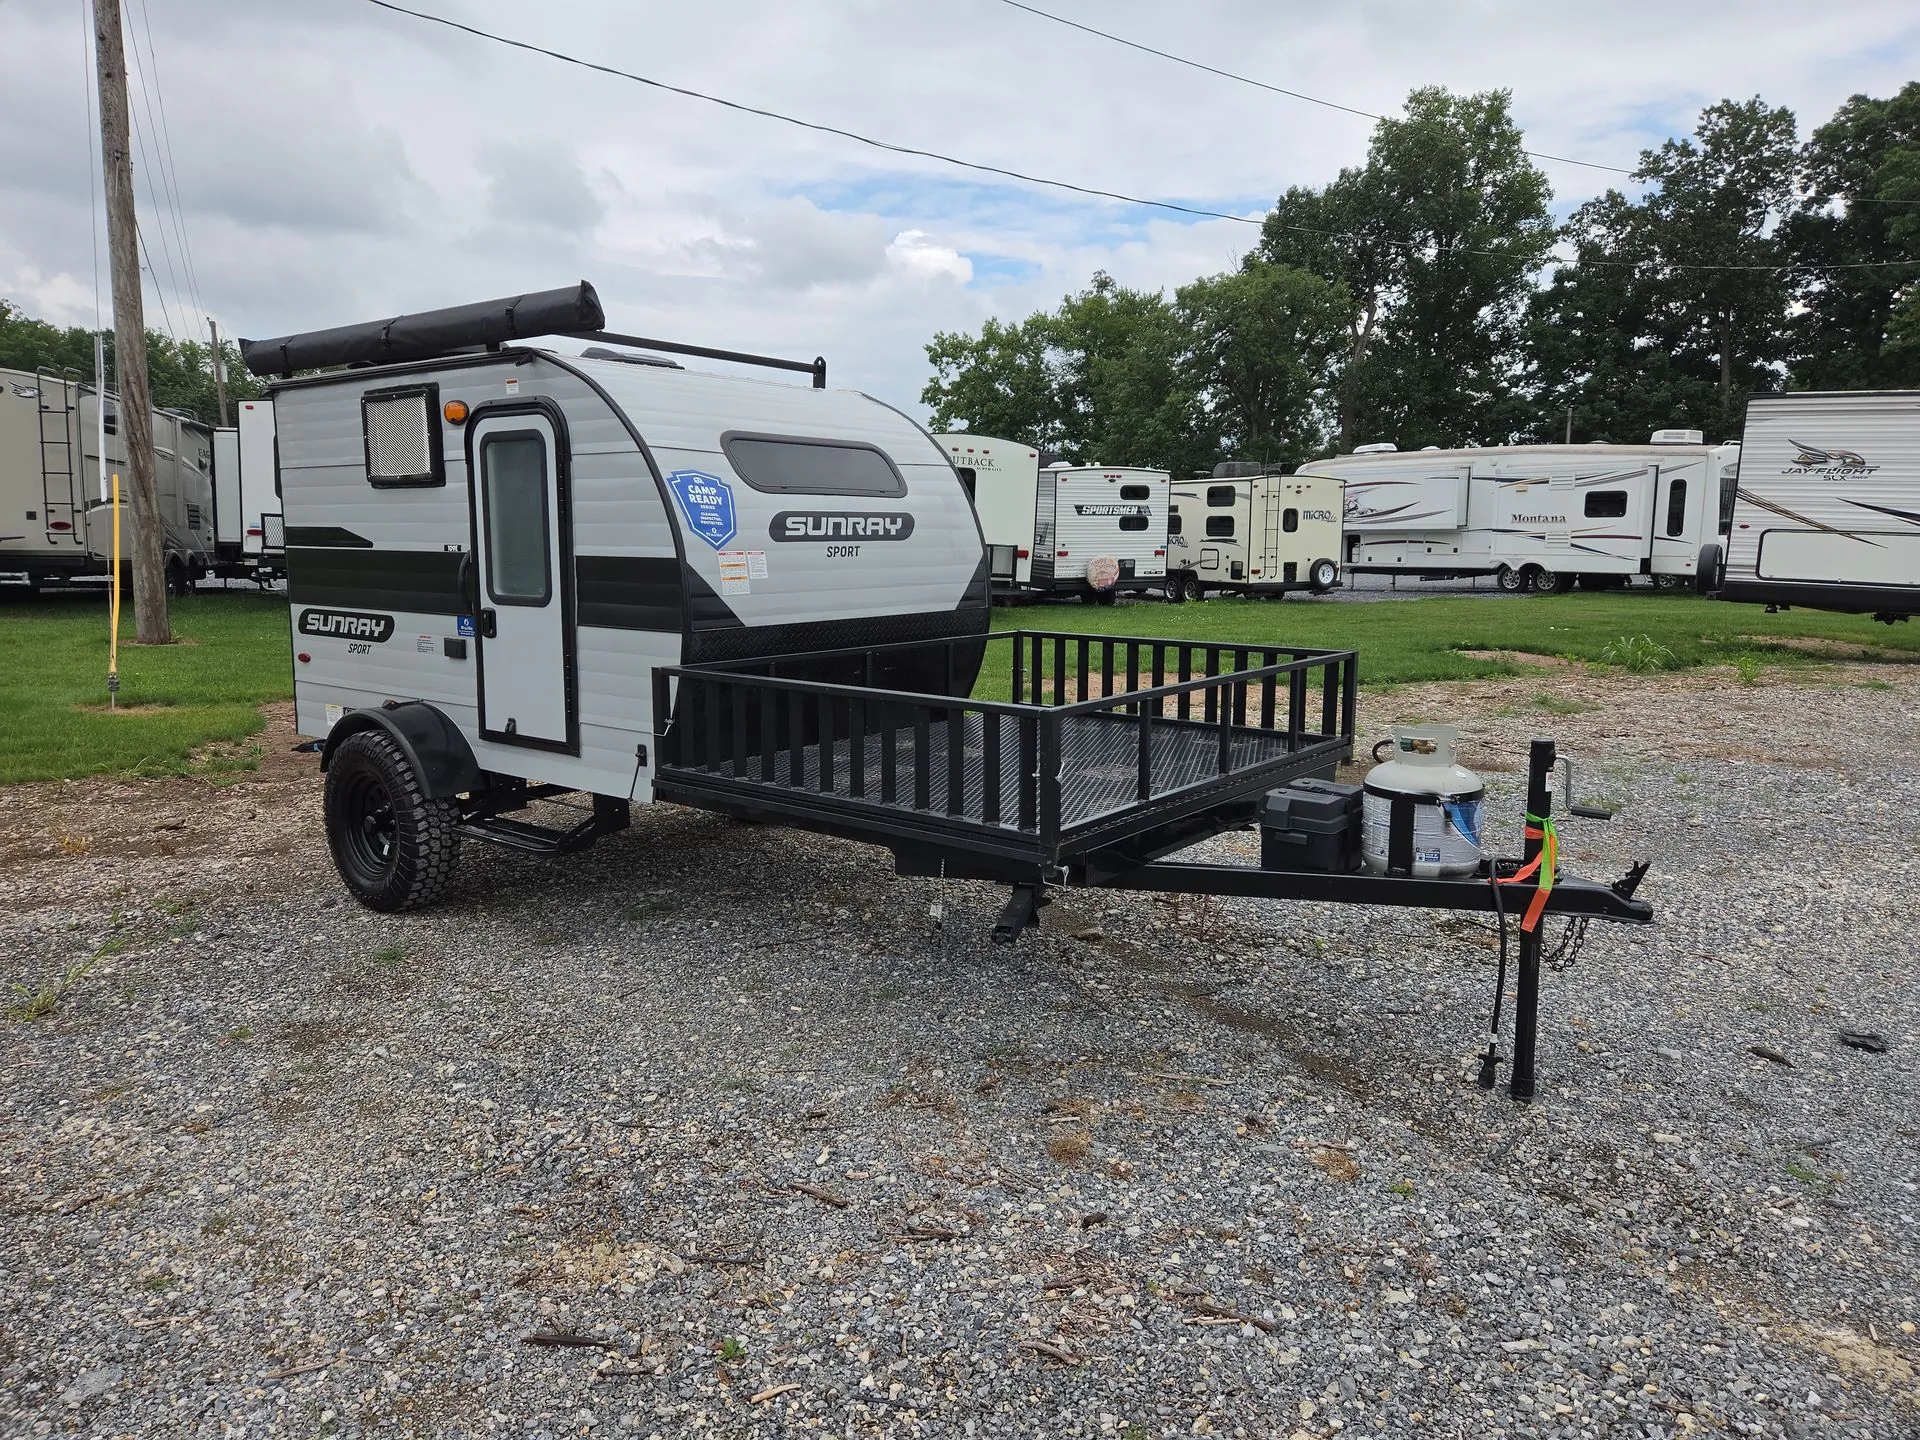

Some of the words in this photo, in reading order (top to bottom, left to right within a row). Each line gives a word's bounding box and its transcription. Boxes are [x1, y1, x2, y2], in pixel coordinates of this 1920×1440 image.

[950, 456, 995, 467] UTBACK
[687, 484, 717, 495] CAMP
[688, 493, 723, 505] READY
[1081, 505, 1139, 515] SPORTSMEN
[1511, 514, 1567, 524] Montana
[785, 516, 902, 536] SUNRAY
[826, 546, 860, 558] SPORT
[306, 613, 385, 637] SUNRAY
[347, 643, 372, 655] SPORT
